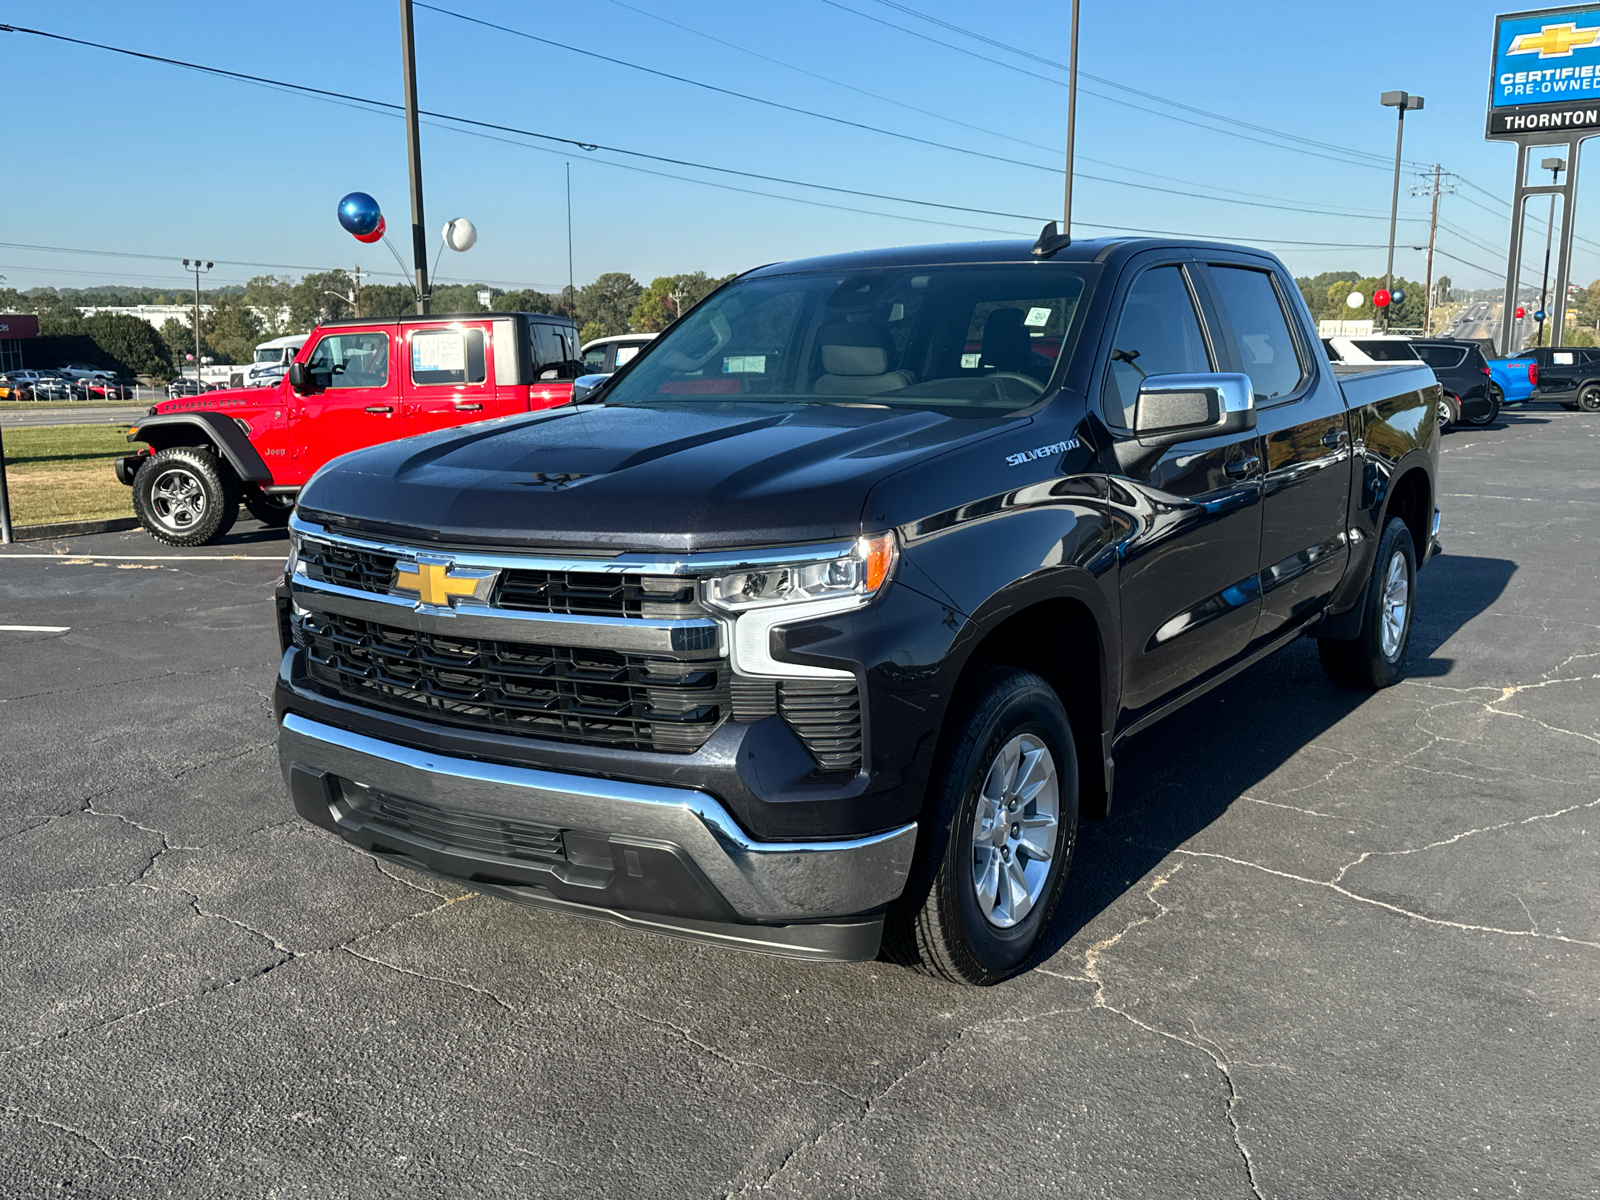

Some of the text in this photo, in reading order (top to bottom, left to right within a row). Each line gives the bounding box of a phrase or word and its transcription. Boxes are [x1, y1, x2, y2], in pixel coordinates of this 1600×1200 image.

[1504, 110, 1597, 129] THORNTON
[165, 399, 245, 411] RUBICON
[264, 447, 286, 456] Jeep
[1005, 438, 1080, 466] SILVERADO
